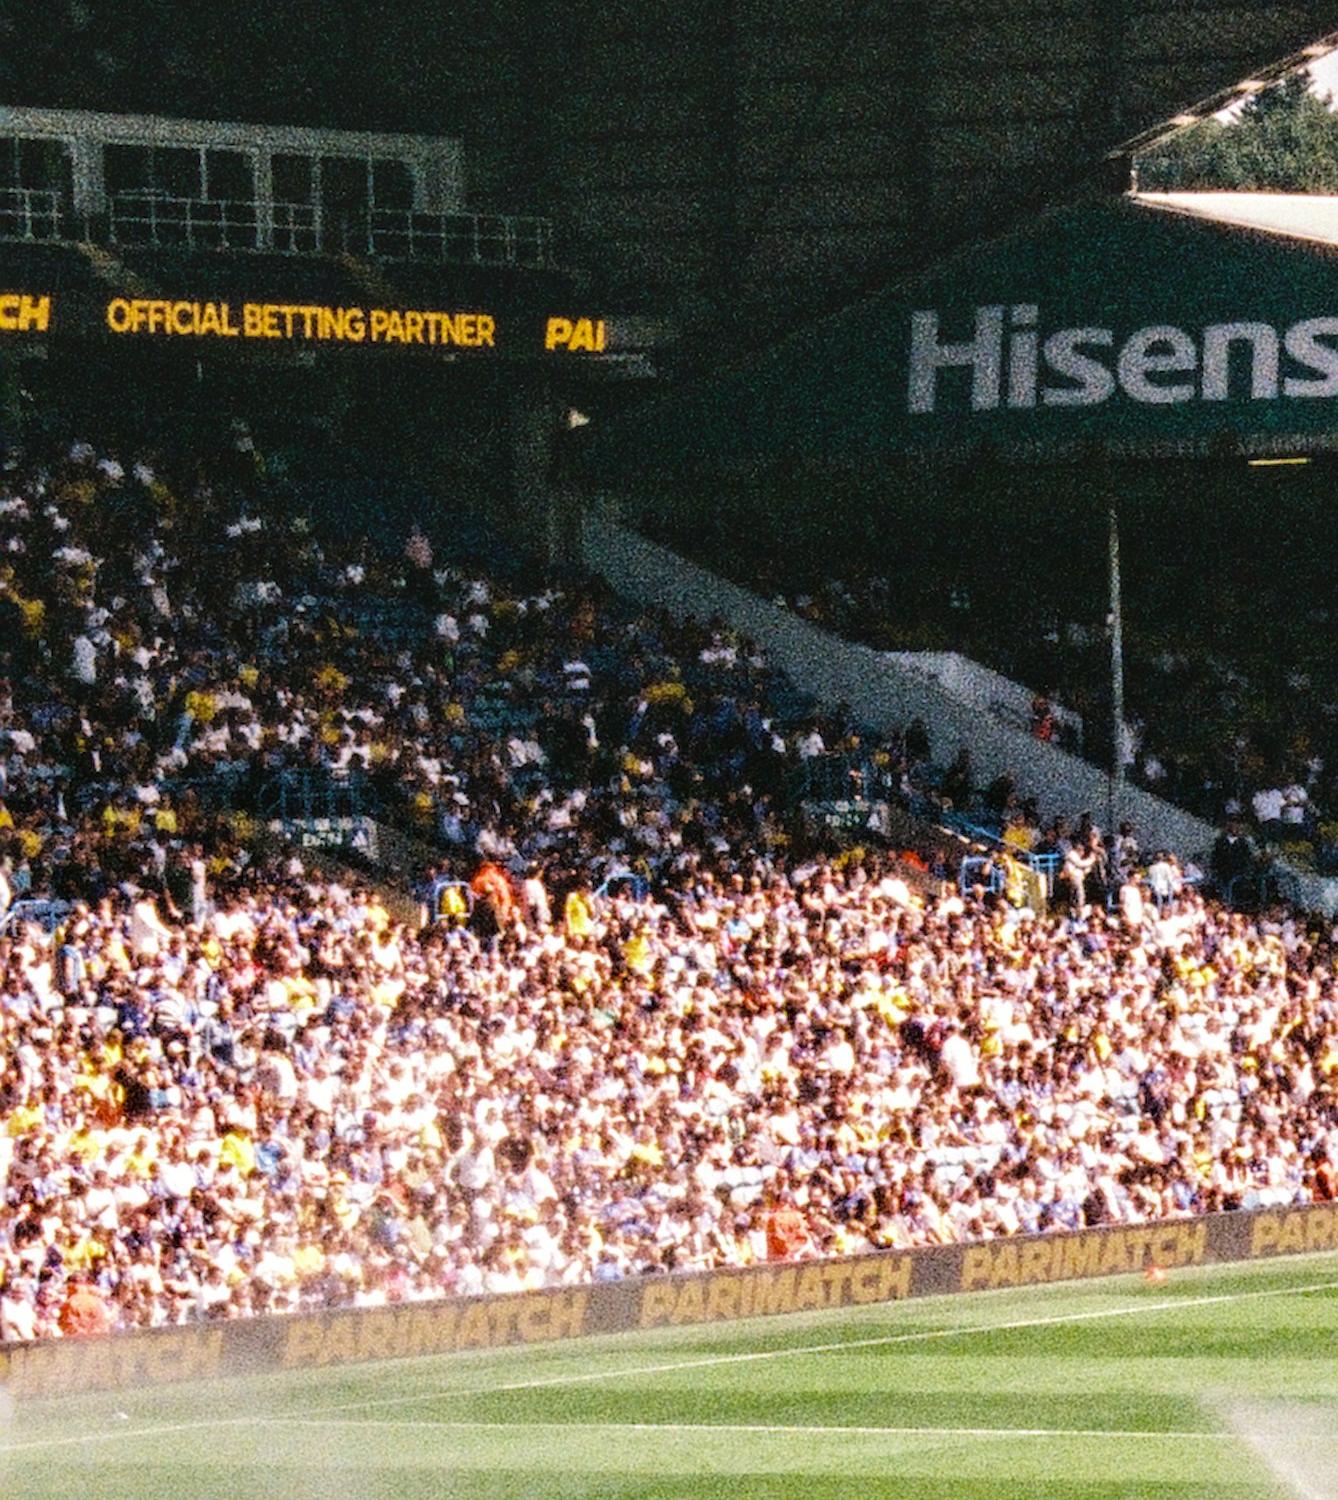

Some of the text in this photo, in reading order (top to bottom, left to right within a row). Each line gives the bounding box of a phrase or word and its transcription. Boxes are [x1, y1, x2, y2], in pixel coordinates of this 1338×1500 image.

[106, 297, 495, 348] OFFICIAL BETTING PARTNER
[962, 1222, 1208, 1290] PARIMATCH
[640, 1256, 912, 1327] PARIMATCH
